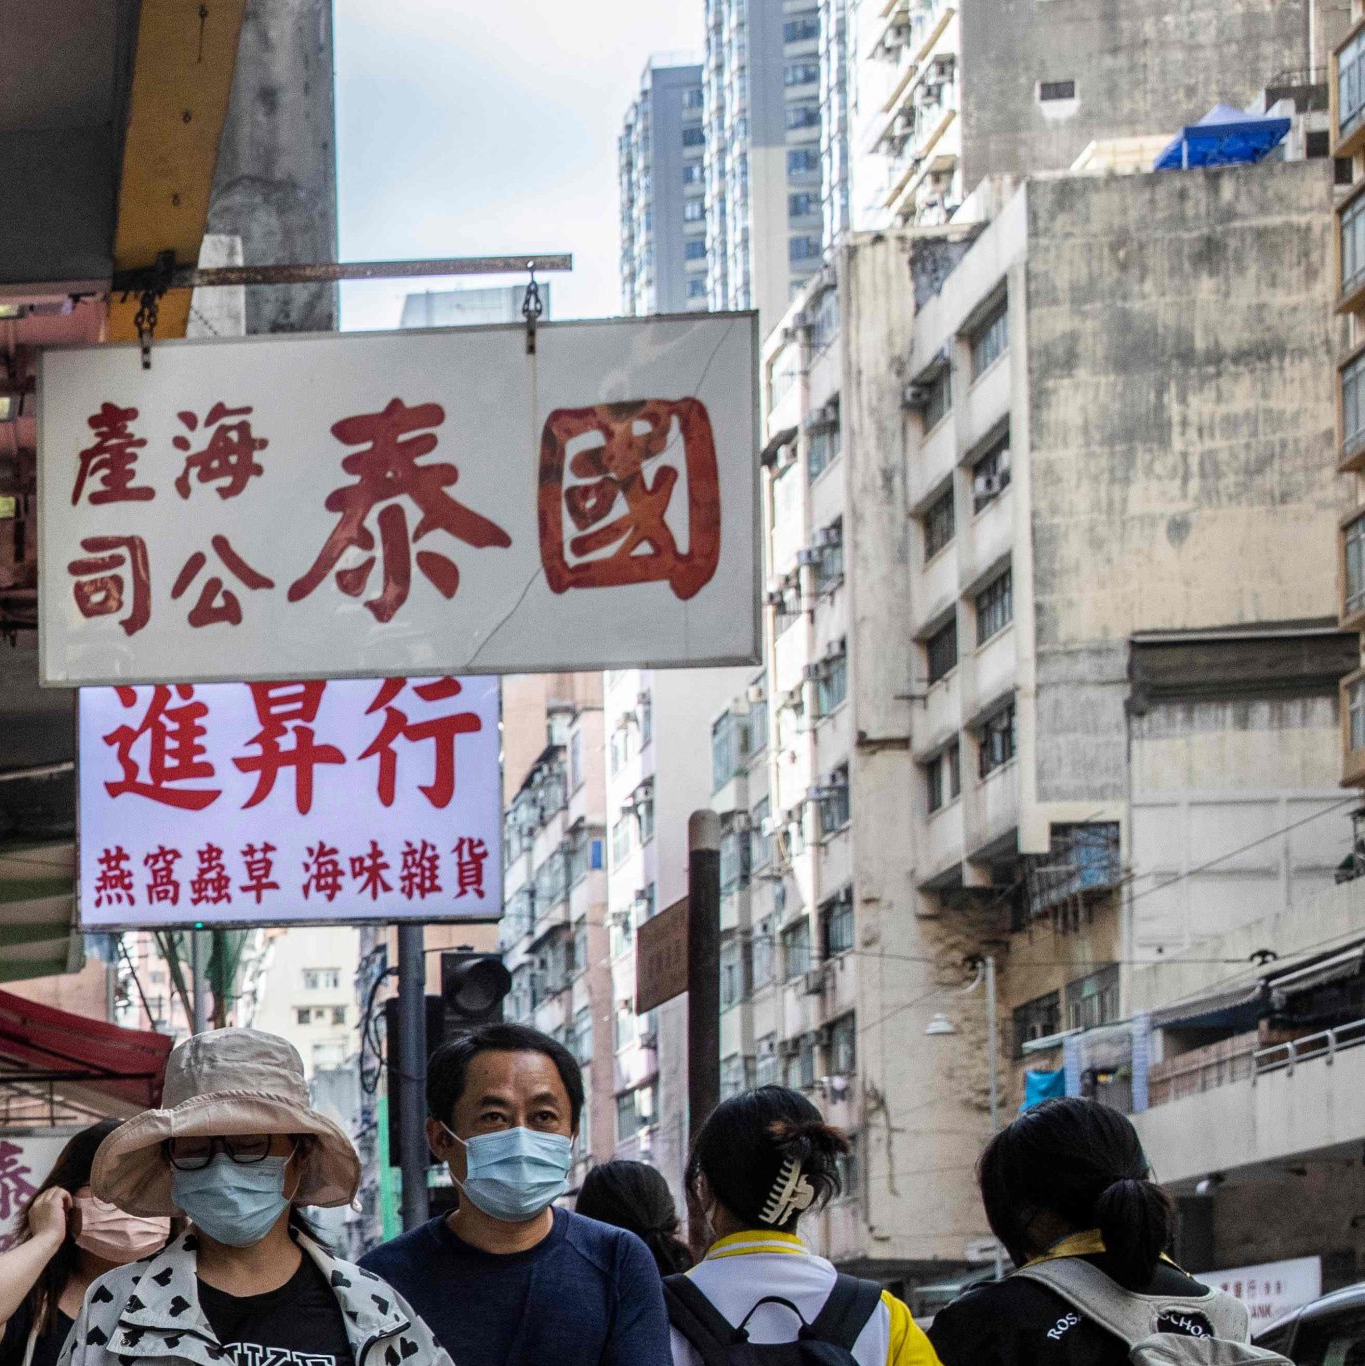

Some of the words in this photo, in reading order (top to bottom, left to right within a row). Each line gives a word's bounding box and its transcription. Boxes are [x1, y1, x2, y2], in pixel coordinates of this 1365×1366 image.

[102, 680, 482, 816] 進昇行
[93, 842, 280, 909] 燕窩蟲草
[302, 836, 490, 906] 海味雜貨
[1046, 1312, 1082, 1340] ROS
